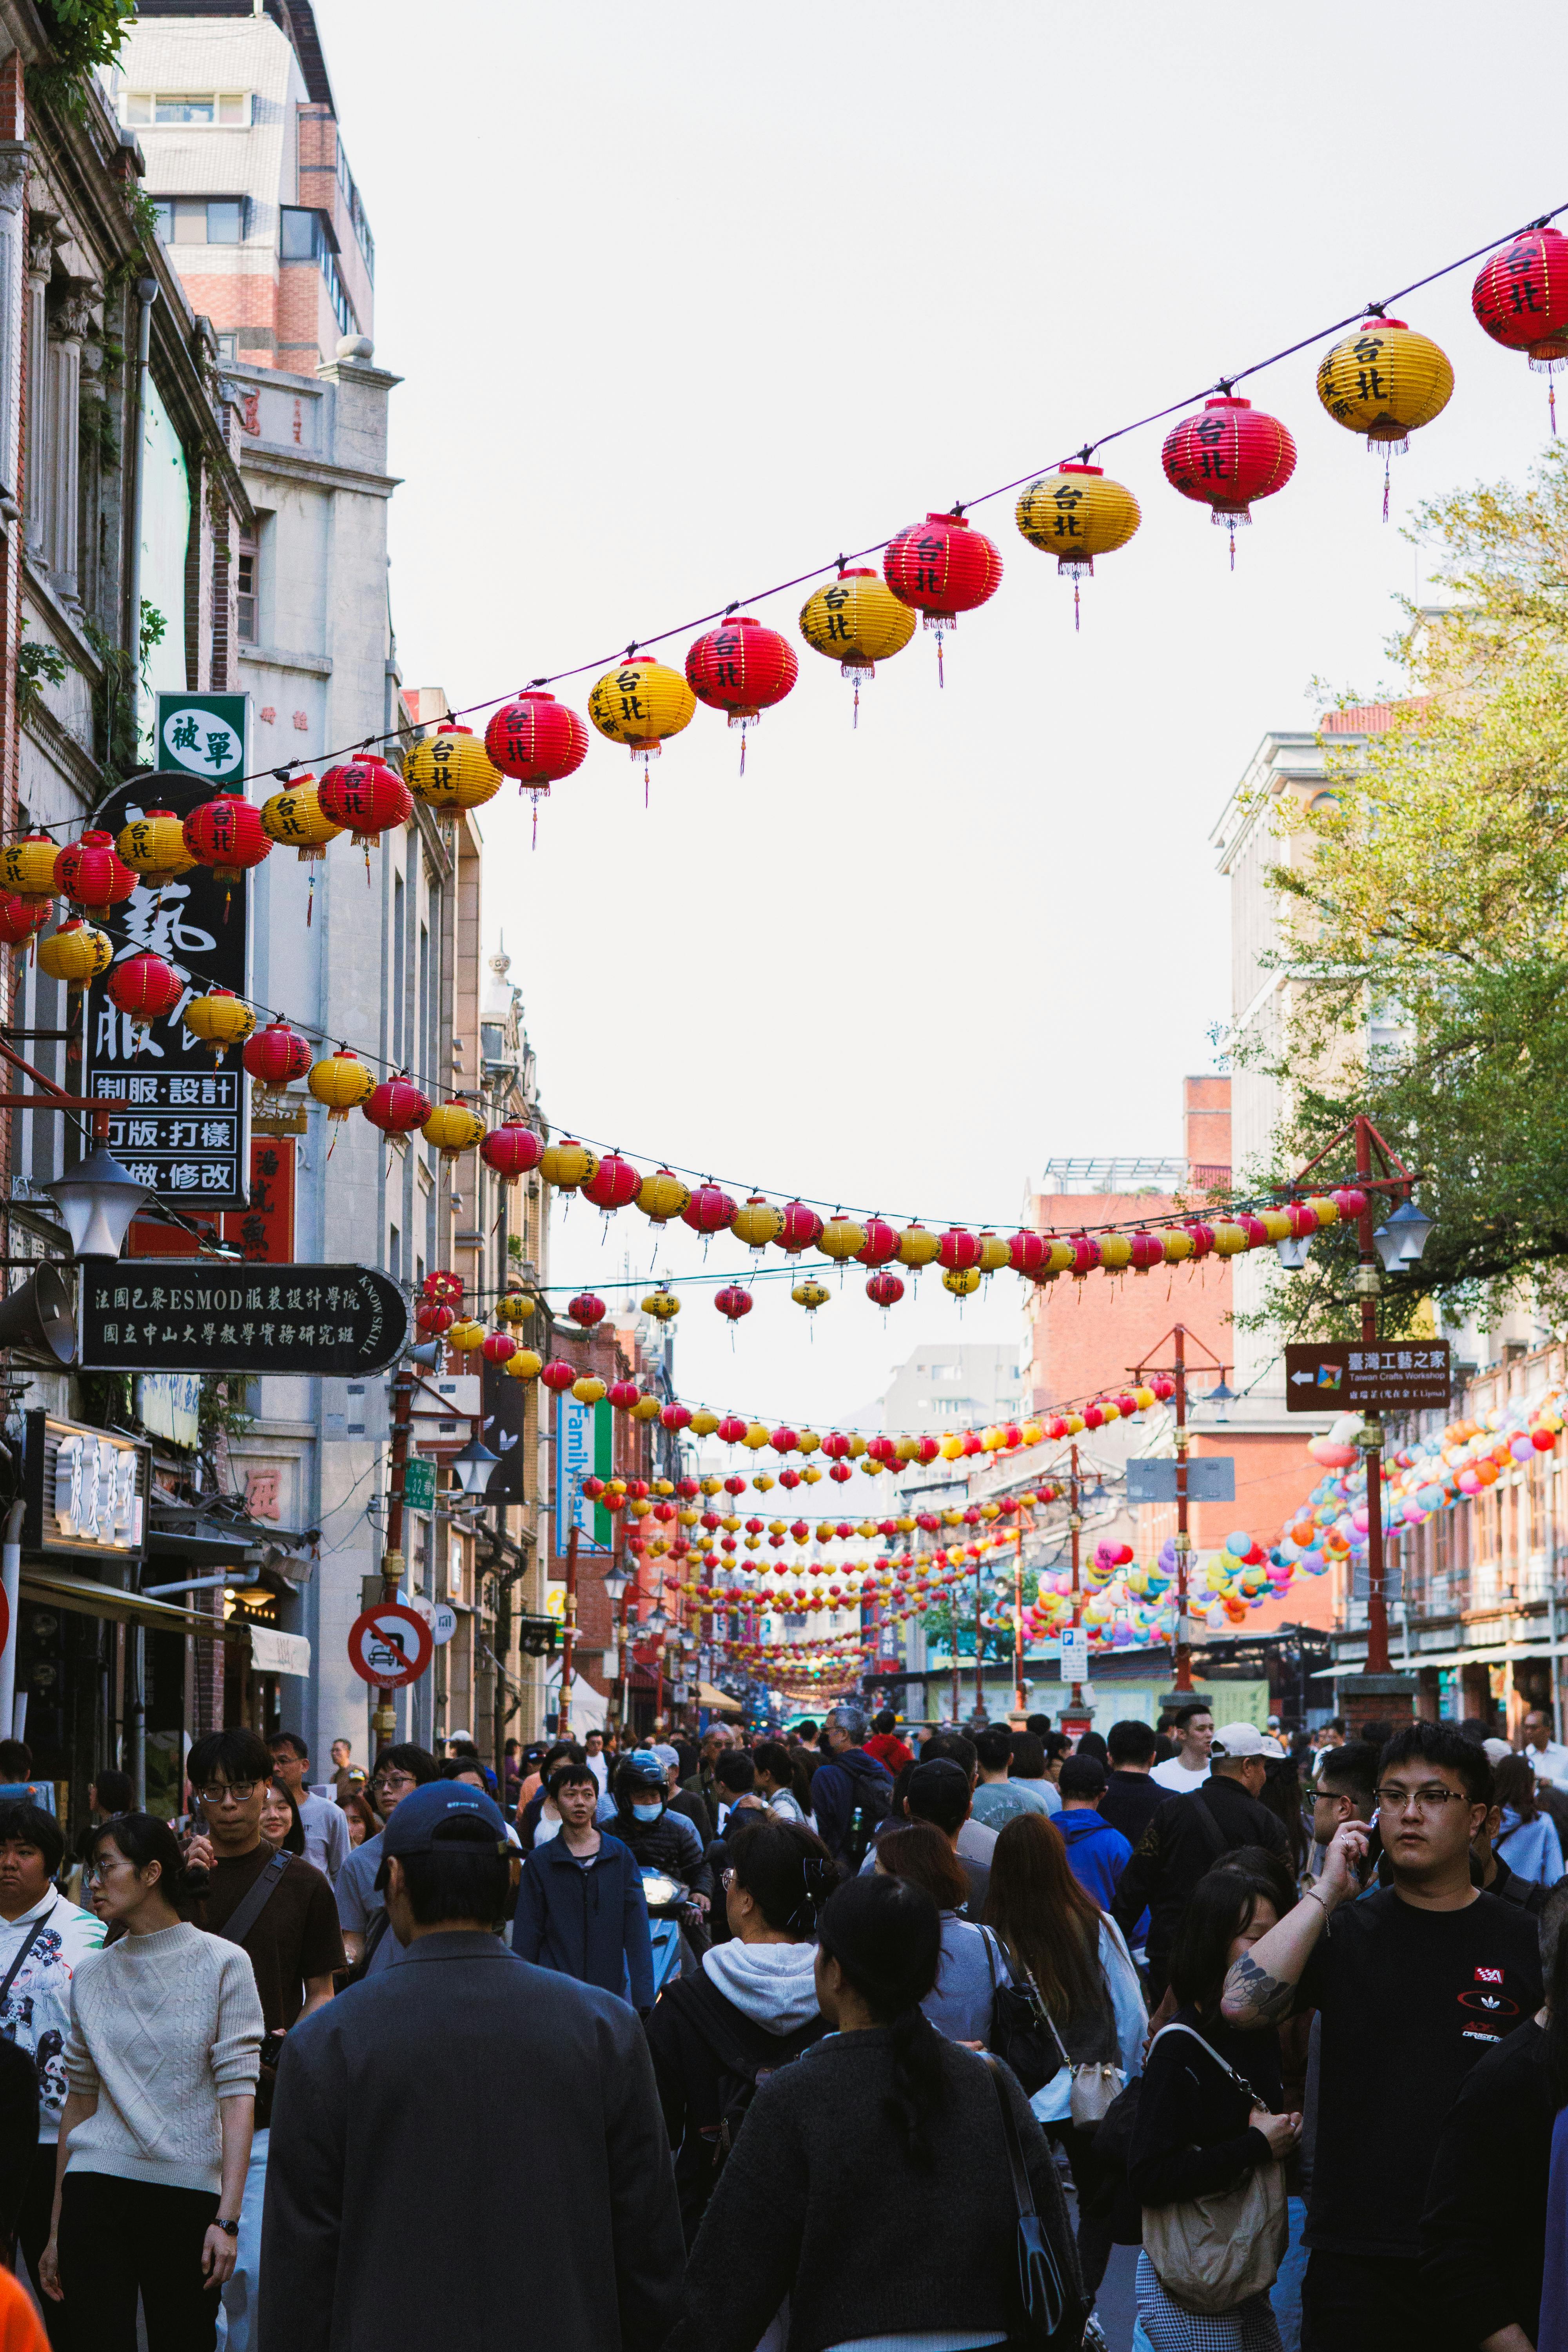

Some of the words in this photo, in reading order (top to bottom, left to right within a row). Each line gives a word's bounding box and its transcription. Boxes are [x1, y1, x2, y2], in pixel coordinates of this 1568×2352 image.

[1505, 246, 1544, 315] 台北
[1353, 337, 1388, 401] 台北
[1197, 417, 1229, 479] 台北
[1053, 485, 1083, 537] 台北
[915, 535, 944, 594] 台北
[824, 587, 853, 641] 台北
[714, 633, 740, 688] 台北
[615, 671, 647, 721] 台北
[172, 716, 233, 769] 被單
[505, 710, 530, 763] 台北
[431, 740, 455, 790] 台北
[343, 769, 366, 814] 台北
[211, 807, 232, 852] 台北
[276, 797, 306, 835] 台北
[131, 823, 152, 858] 台北
[6, 848, 25, 882] 台北
[62, 856, 80, 898] 台北
[126, 1163, 230, 1189] 做·修改
[358, 1275, 383, 1313] KNOW
[885, 1279, 895, 1299] 台北
[959, 1271, 968, 1290] 台北
[513, 1299, 523, 1316] 台北
[666, 1298, 675, 1314] 台北
[735, 1294, 744, 1313] 台北
[104, 1323, 354, 1346] 國立中山大學教學實務研究班
[359, 1316, 383, 1355] SKILL
[1348, 1350, 1445, 1371] 臺灣工藝之家
[1349, 1373, 1377, 1381] Taiwan
[1379, 1372, 1403, 1381] Crafts
[1405, 1372, 1445, 1381] Workshop
